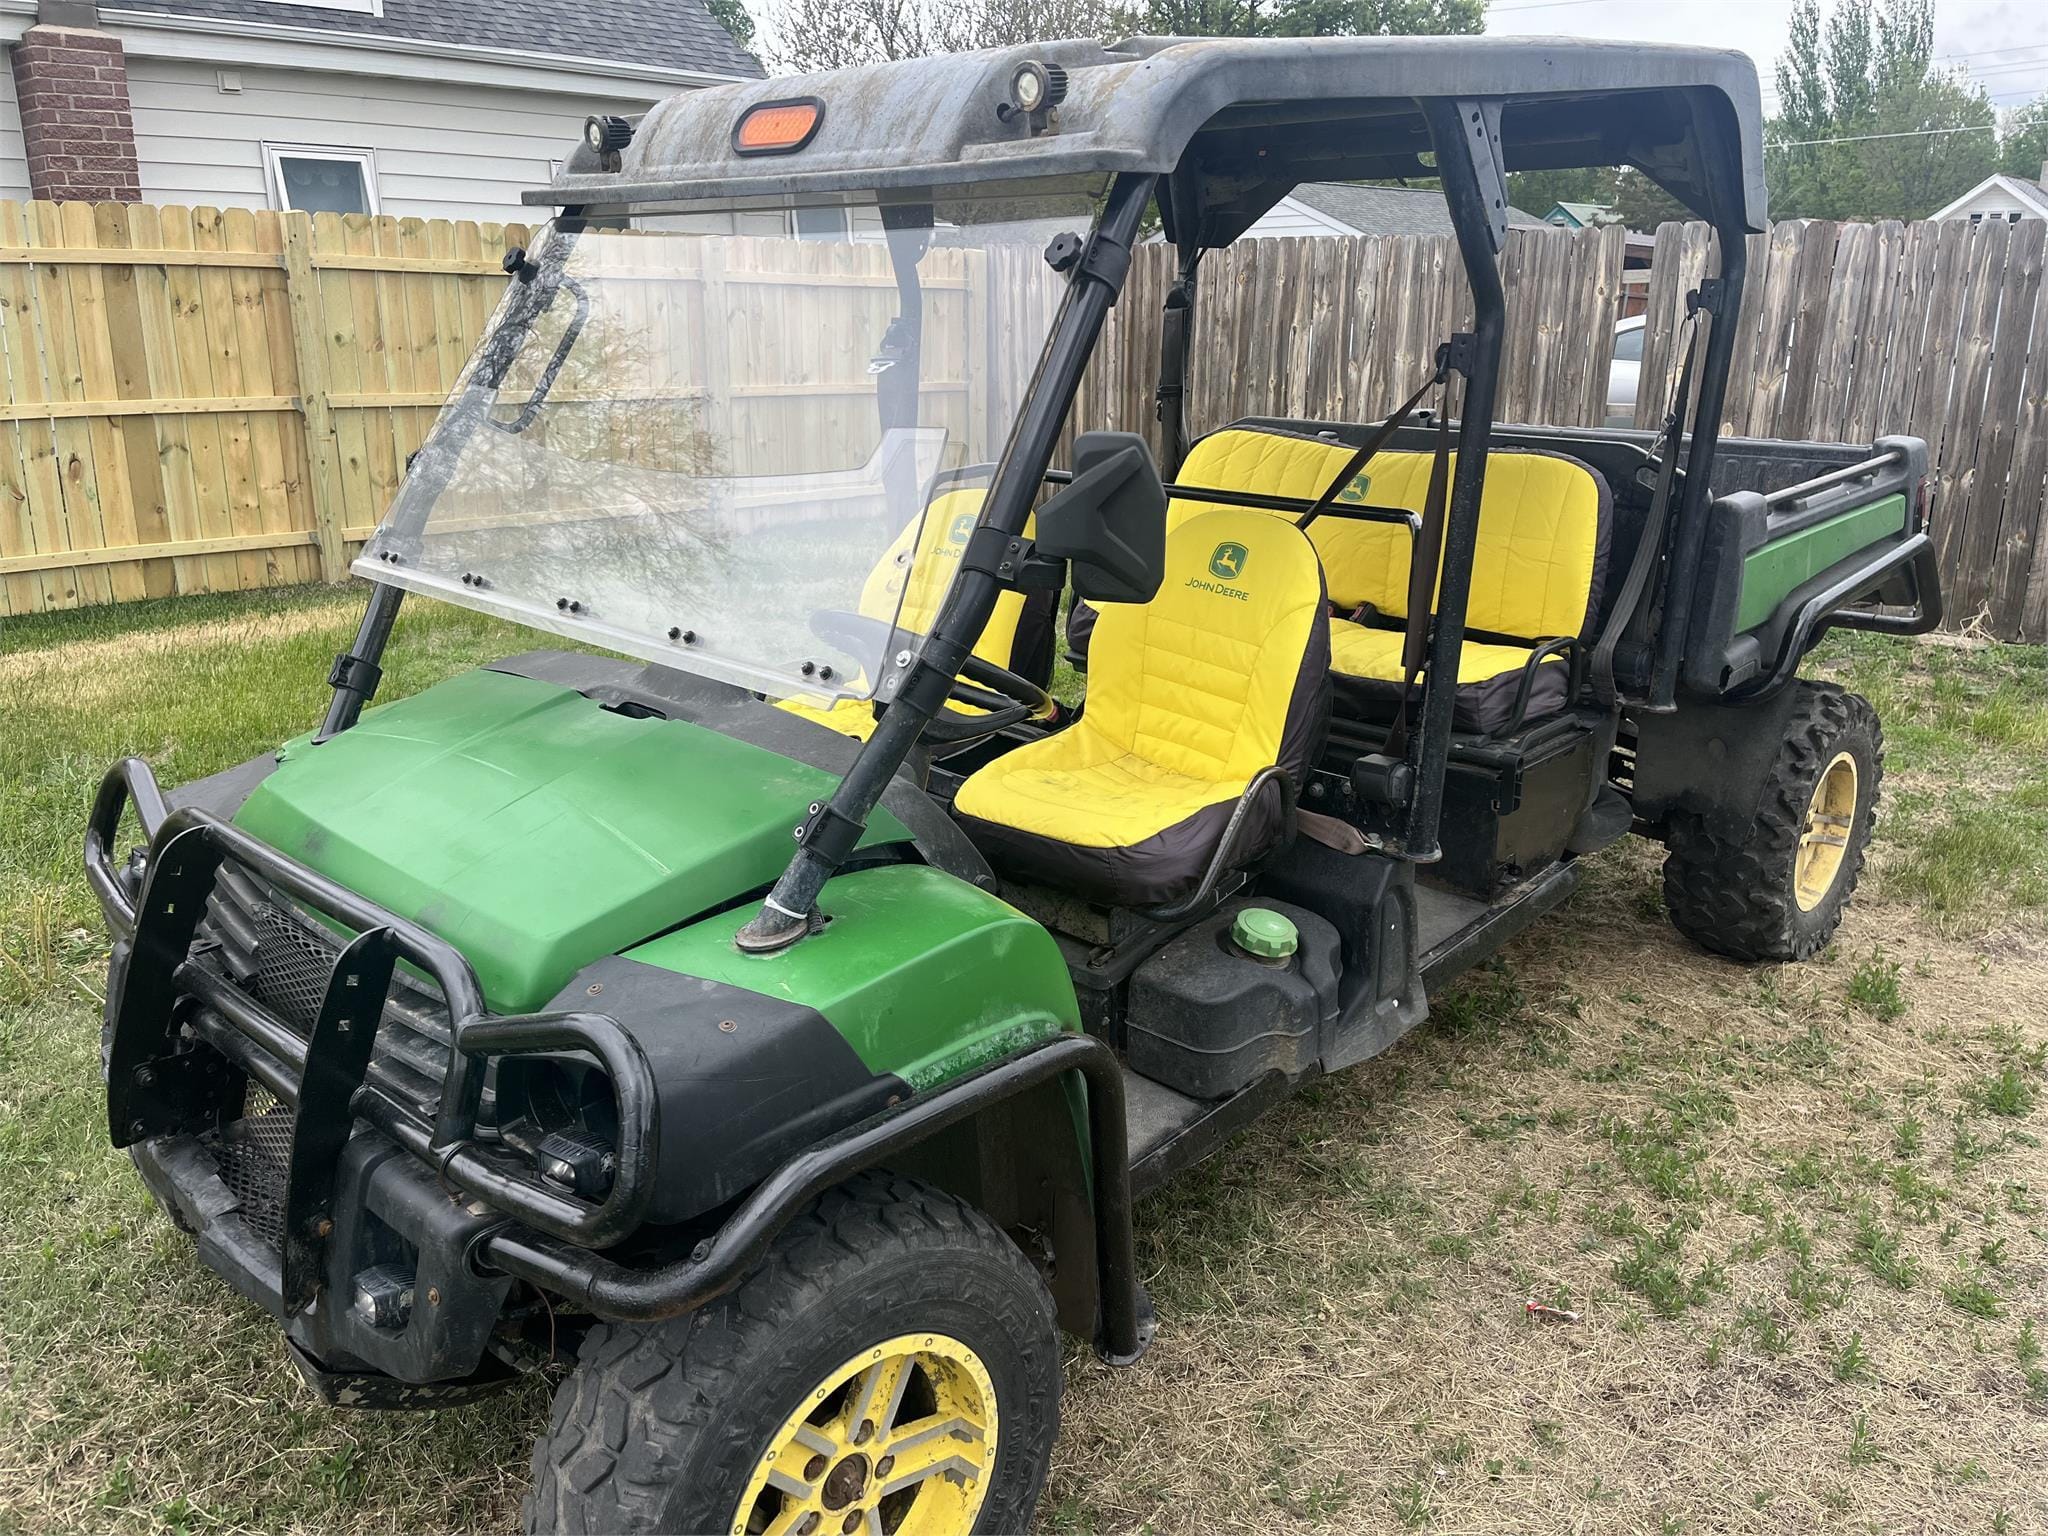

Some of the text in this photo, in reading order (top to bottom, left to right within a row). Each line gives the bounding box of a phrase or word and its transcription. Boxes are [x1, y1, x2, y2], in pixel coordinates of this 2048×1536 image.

[930, 546, 952, 557] JOHN
[1185, 577, 1250, 601] JOHN DEERE
